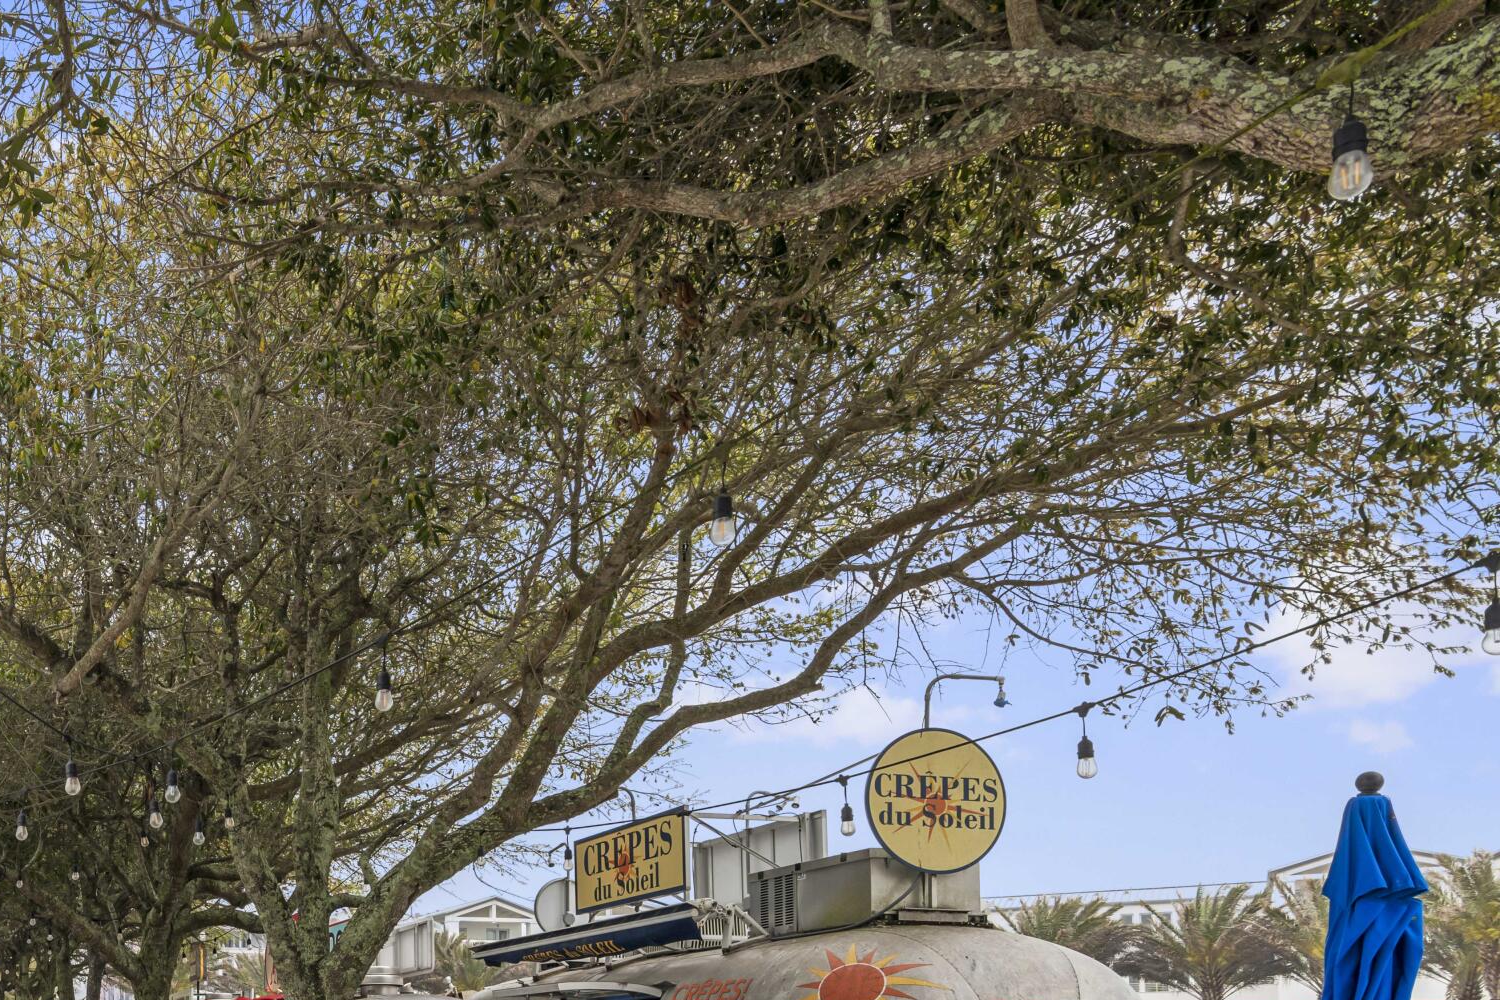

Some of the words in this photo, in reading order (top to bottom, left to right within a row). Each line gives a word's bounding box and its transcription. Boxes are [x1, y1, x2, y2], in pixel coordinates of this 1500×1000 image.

[874, 771, 997, 803] CRÊPES
[878, 802, 912, 827] du
[922, 803, 995, 831] Soleil
[583, 820, 673, 877] CRÊPES
[594, 878, 612, 902] du
[616, 862, 660, 897] Soleil
